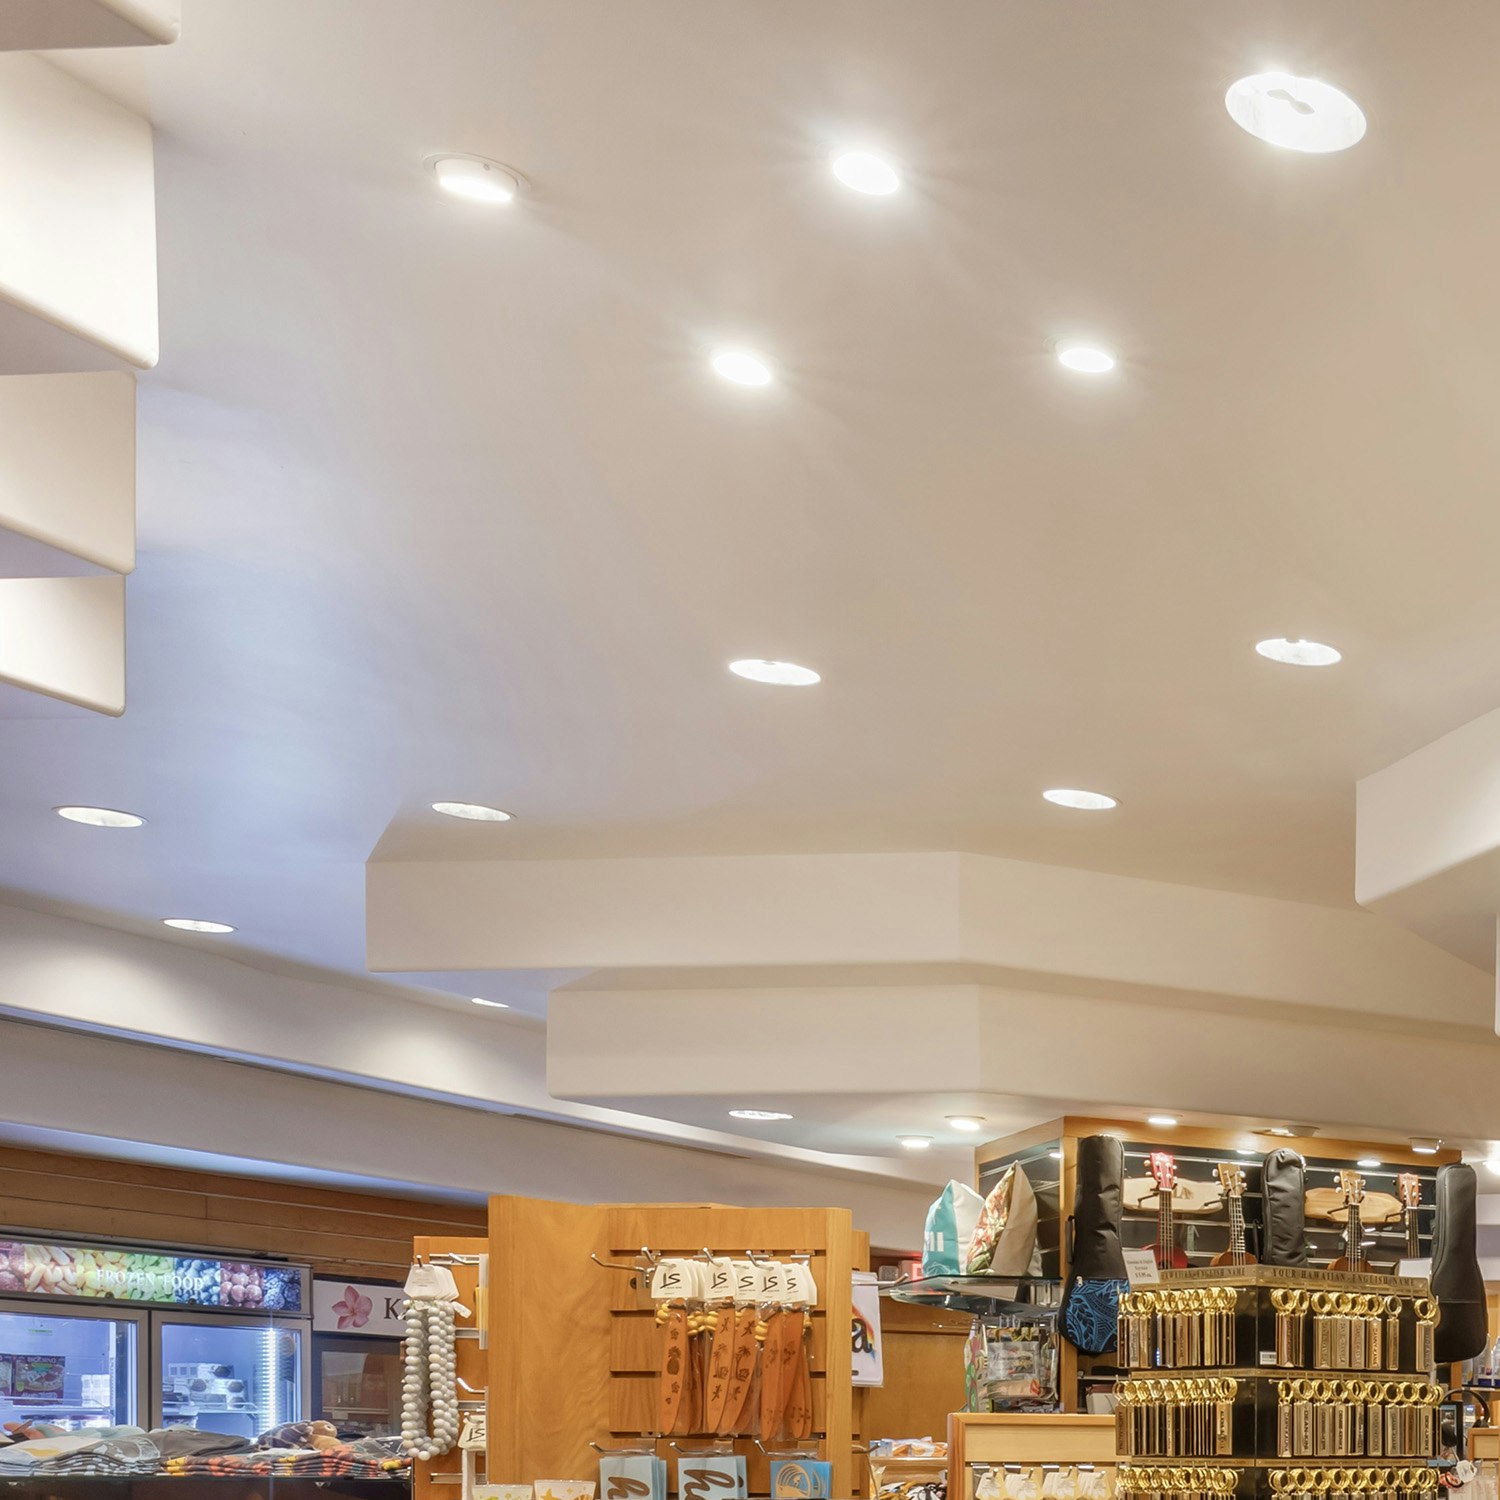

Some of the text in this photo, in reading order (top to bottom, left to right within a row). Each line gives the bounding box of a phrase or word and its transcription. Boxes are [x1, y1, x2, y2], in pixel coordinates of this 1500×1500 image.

[97, 1269, 205, 1291] FROZEN FOOD
[1271, 1268, 1297, 1277] YOUR
[1391, 1276, 1415, 1285] NAME
